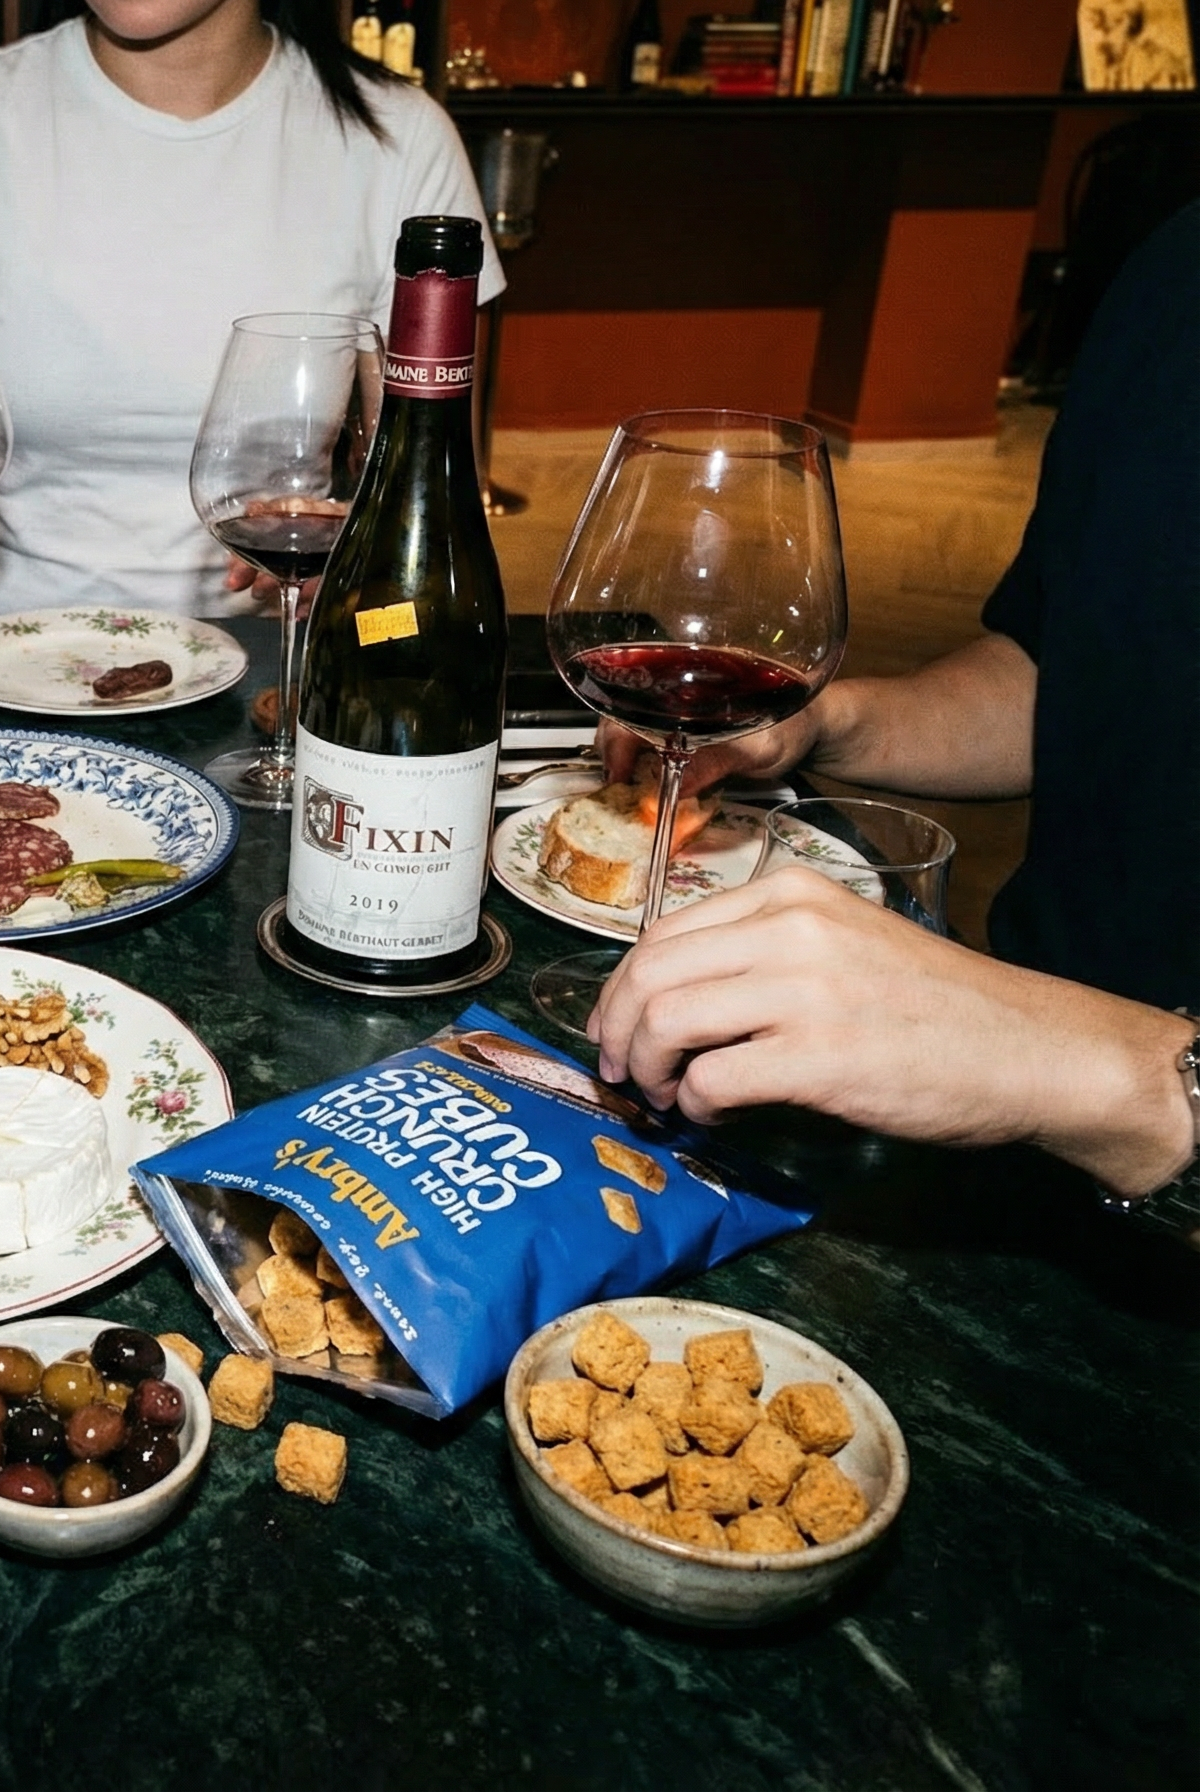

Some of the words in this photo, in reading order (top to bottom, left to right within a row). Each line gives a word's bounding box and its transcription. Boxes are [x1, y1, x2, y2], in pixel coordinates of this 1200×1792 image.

[330, 798, 457, 853] FIXIN
[349, 894, 399, 914] 2019
[297, 1104, 418, 1169] PROTEIN
[318, 1083, 516, 1212] CRUNCH
[363, 1067, 564, 1189] CUBES
[274, 1139, 420, 1249] Ambry's
[410, 1170, 482, 1235] HIGH
